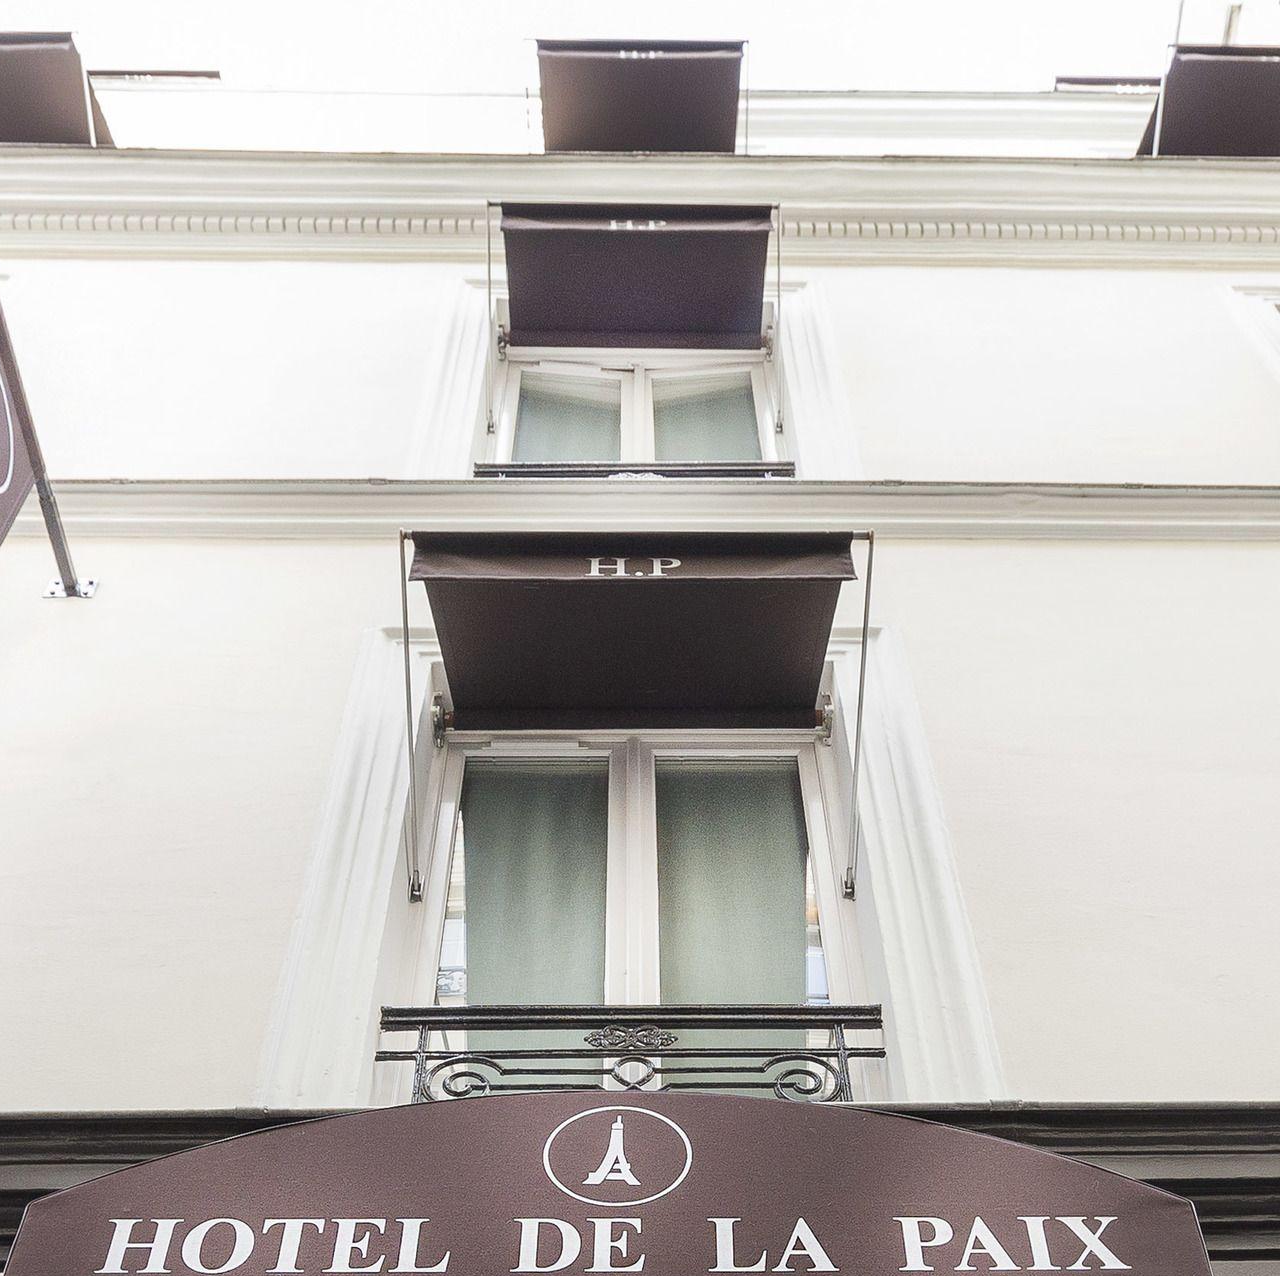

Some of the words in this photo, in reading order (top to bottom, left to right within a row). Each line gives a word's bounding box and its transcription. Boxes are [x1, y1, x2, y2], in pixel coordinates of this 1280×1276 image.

[585, 557, 682, 576] H.P
[94, 1217, 451, 1275] HOTEL
[510, 1217, 646, 1274] DE
[707, 1217, 840, 1273] LA
[897, 1215, 1133, 1271] PAIX
